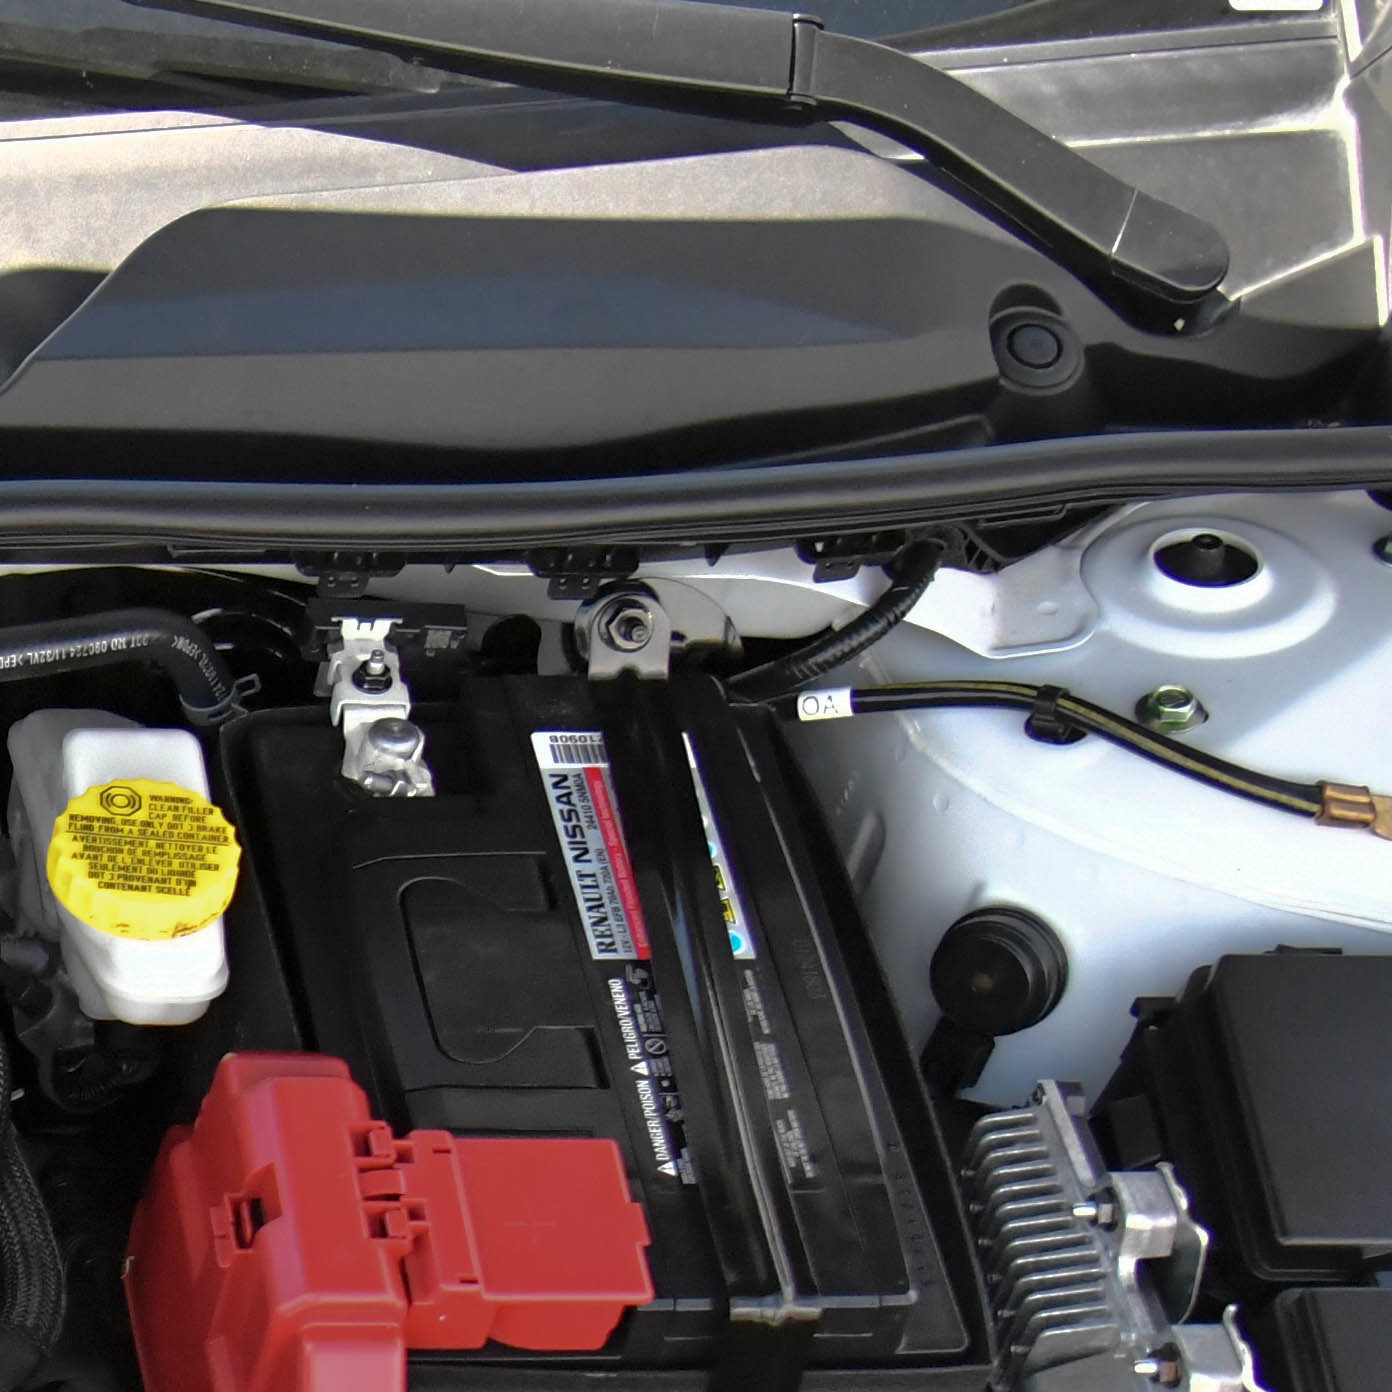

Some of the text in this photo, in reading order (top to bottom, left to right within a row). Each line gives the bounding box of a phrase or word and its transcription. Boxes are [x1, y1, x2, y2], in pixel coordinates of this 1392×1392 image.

[148, 803, 214, 815] CLEAN FILLER
[148, 812, 207, 823] CAP BEFORE
[68, 823, 94, 832] FLUID
[98, 826, 124, 834] FROM
[137, 829, 174, 838] SEALED
[177, 832, 229, 842] CONTAINER
[140, 820, 163, 829] ONLY
[197, 825, 228, 834] BRAKE
[82, 844, 206, 860] BOUCHON DE REMPLISSAGE
[155, 842, 203, 852] NETTOYER
[206, 846, 218, 854] LE
[72, 852, 104, 861] AVANT
[107, 855, 118, 863] DE
[179, 862, 220, 871] UTILISER
[88, 862, 143, 873] SEULEMENT
[146, 867, 158, 875] DU
[549, 774, 618, 954] RENAULT NISSAN
[88, 871, 104, 880] DOT
[117, 874, 172, 884] PROVENANT
[98, 881, 153, 892] CONTENANT
[608, 978, 642, 1060] PELIGRO/VENENO
[635, 1079, 670, 1161] DANGER/POISON
